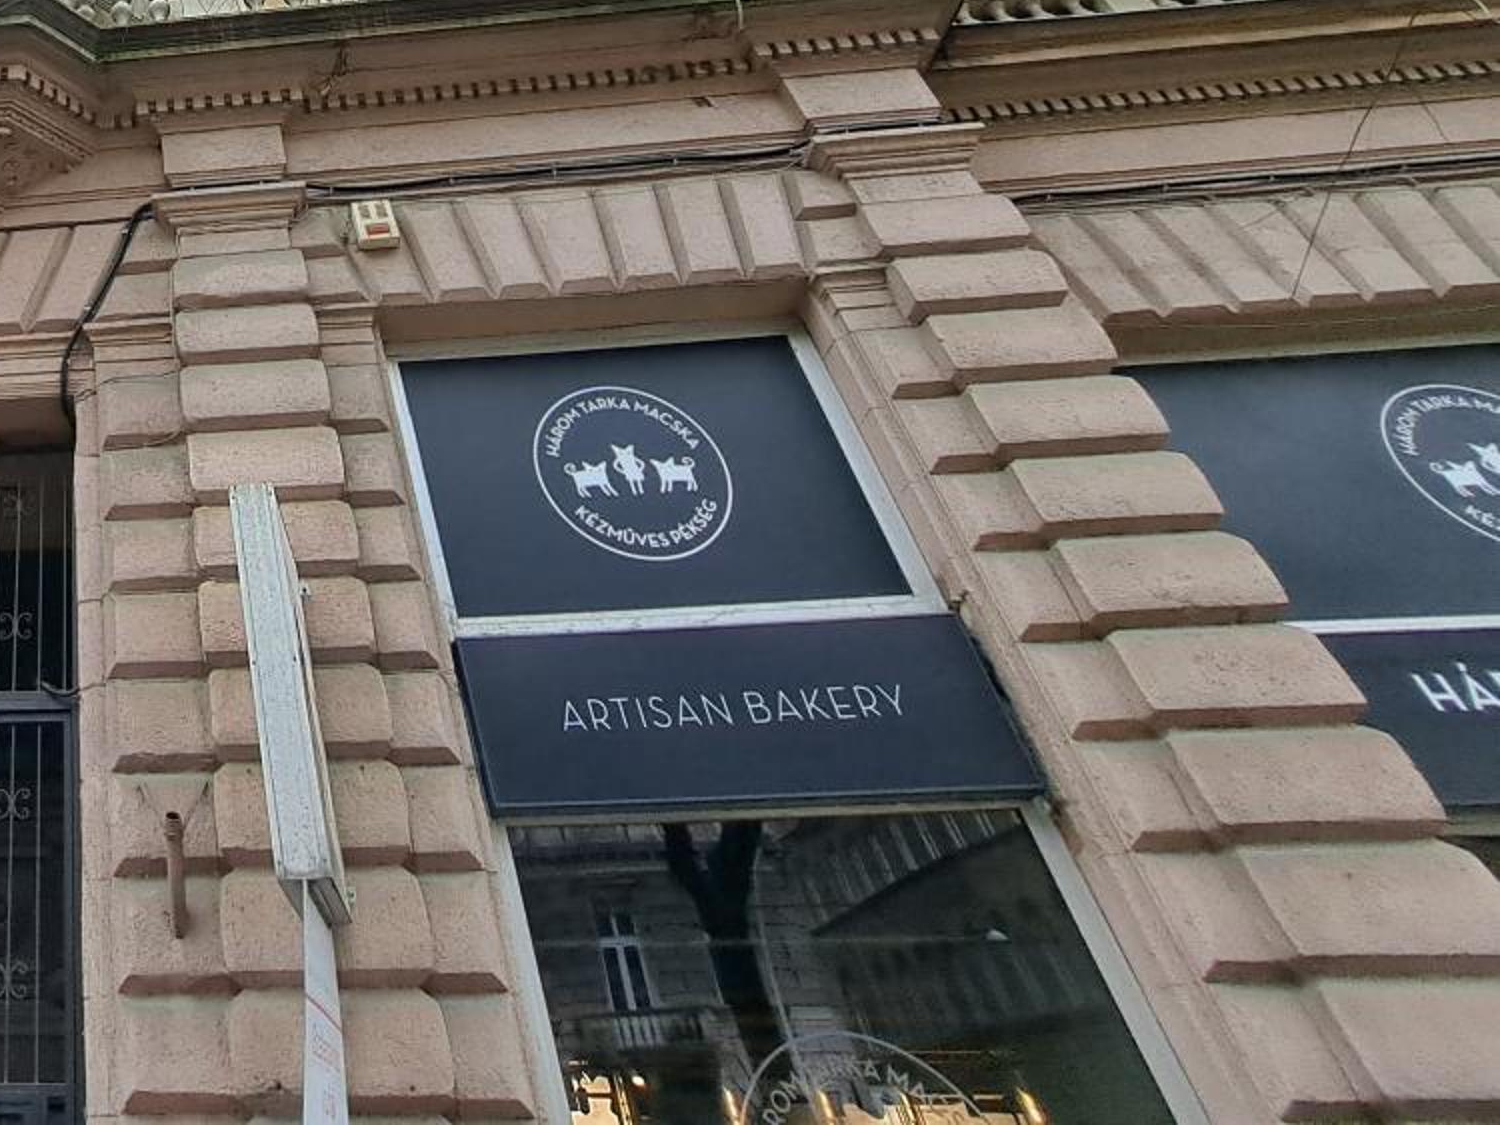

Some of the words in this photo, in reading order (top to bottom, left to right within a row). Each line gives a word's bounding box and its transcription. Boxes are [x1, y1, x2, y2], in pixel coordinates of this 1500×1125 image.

[545, 407, 581, 458] HÁROM
[579, 396, 631, 415] TARKA
[633, 400, 701, 450] MACSKA
[669, 498, 718, 545] PÉKSÉG
[563, 693, 734, 732] ARTISAN
[742, 683, 903, 725] BAKERY
[1408, 661, 1500, 712] HÁ
